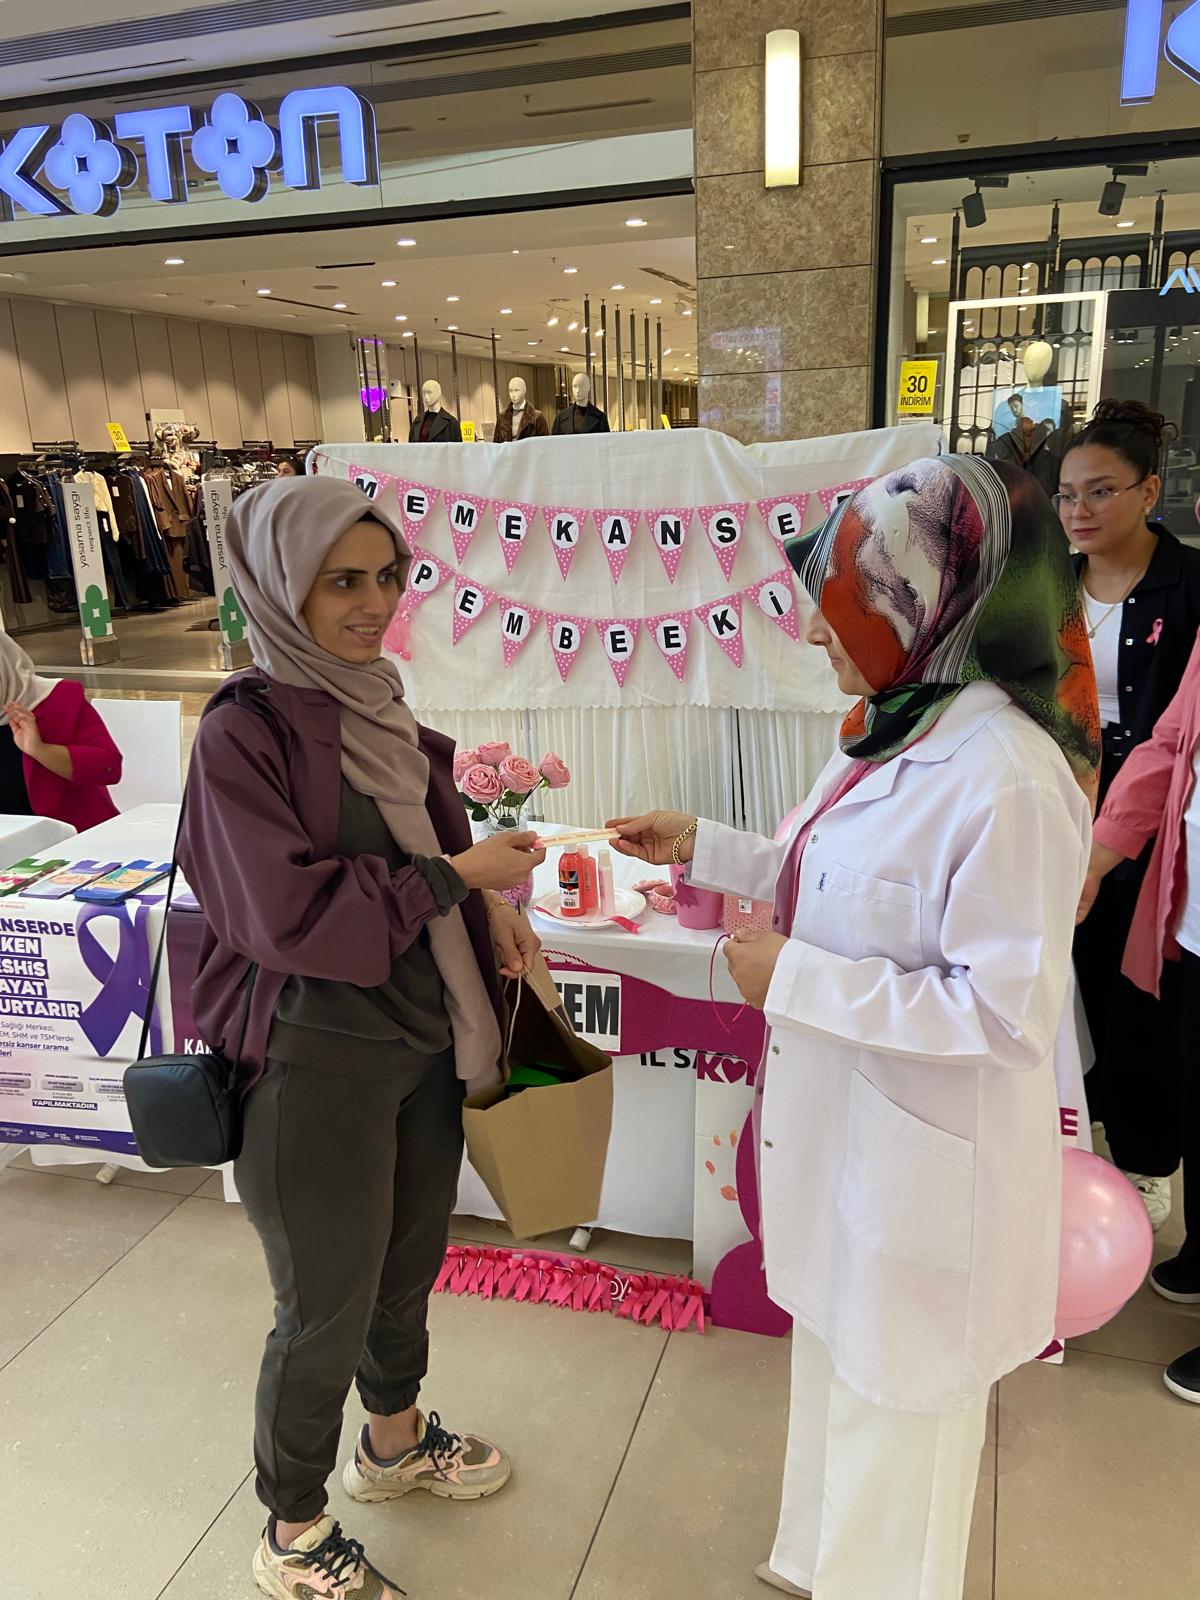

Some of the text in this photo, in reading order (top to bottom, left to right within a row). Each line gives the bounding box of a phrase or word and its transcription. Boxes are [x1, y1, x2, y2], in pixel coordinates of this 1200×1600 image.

[0, 918, 76, 937] NSERDE
[0, 936, 40, 955] KEN
[17, 1041, 43, 1049] kanser
